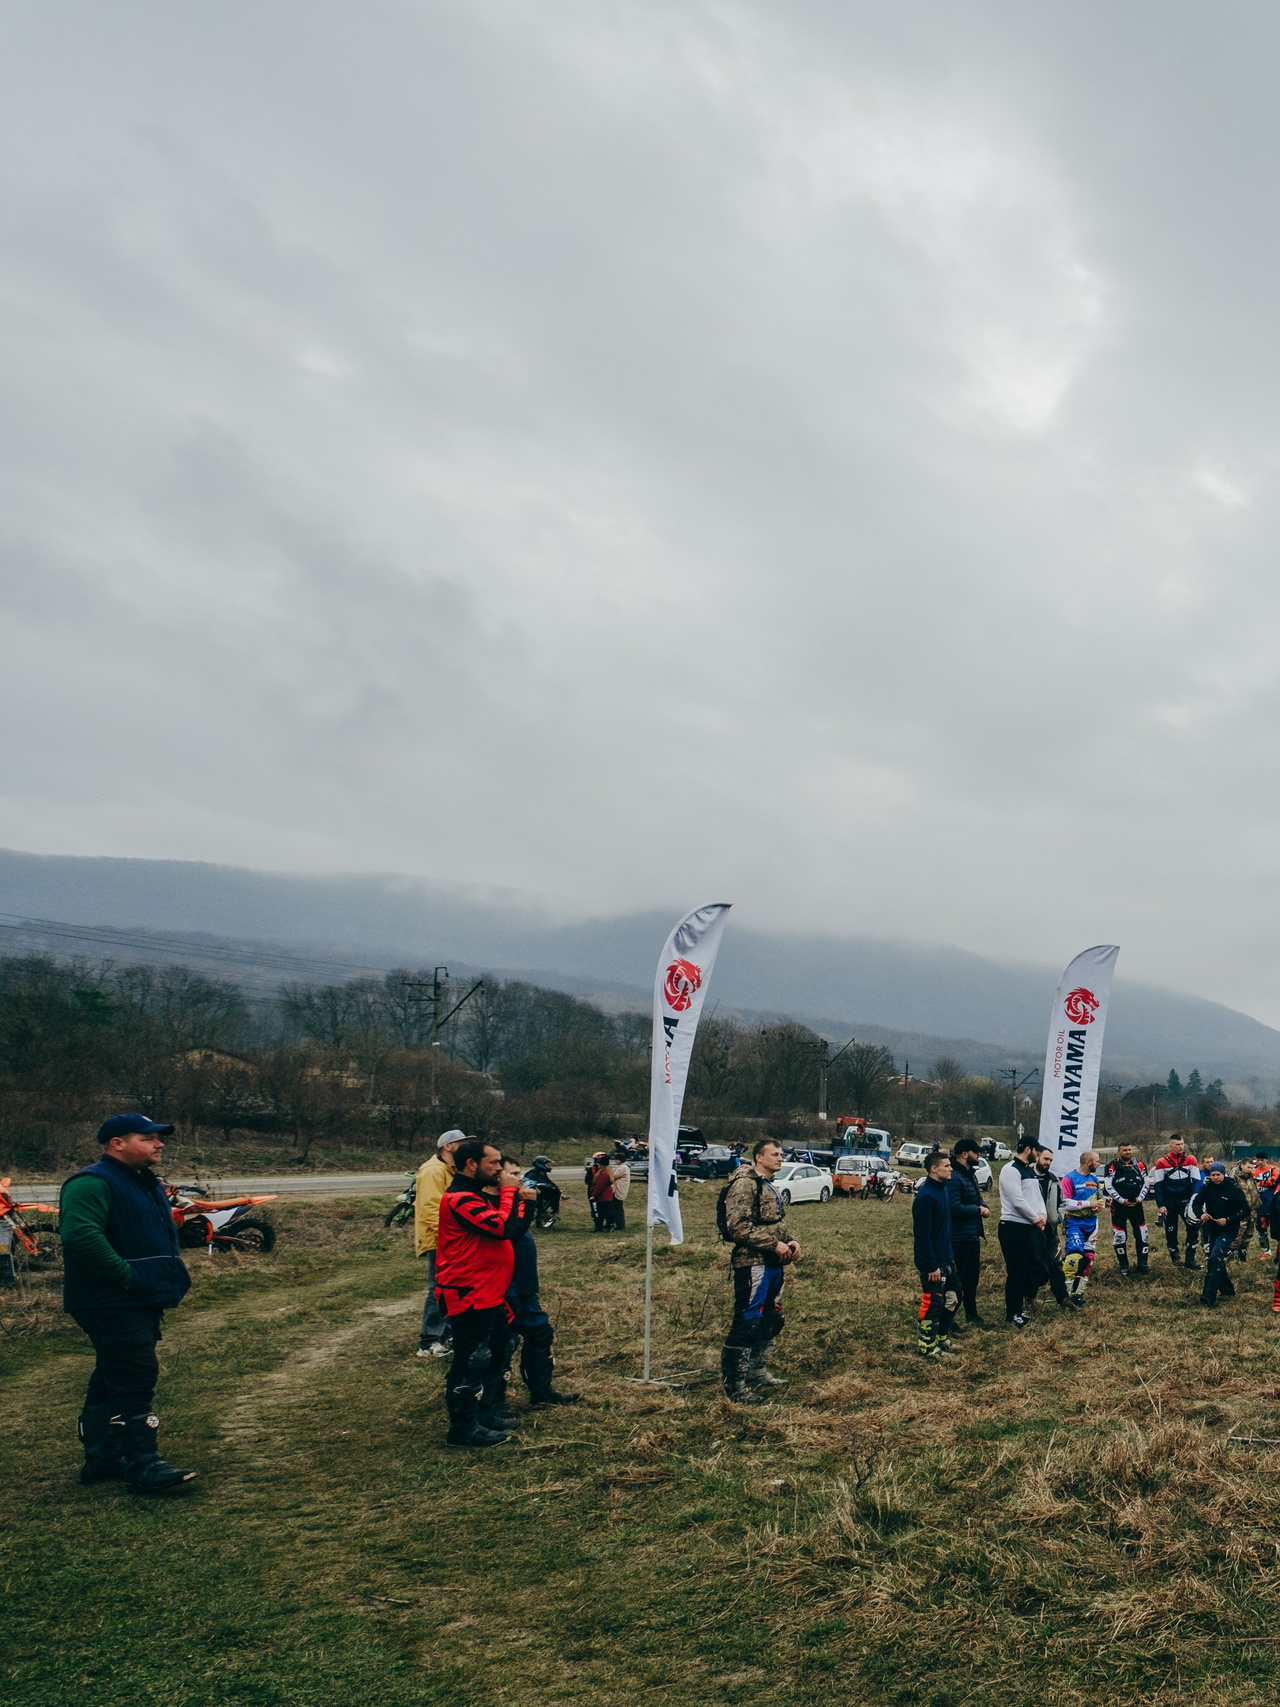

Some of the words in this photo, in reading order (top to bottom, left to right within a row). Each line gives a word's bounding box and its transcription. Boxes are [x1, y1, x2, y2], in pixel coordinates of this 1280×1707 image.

[1057, 1030, 1065, 1045] OIL
[1054, 1046, 1064, 1078] MOTOR
[1058, 1030, 1087, 1150] TAKAYAMA
